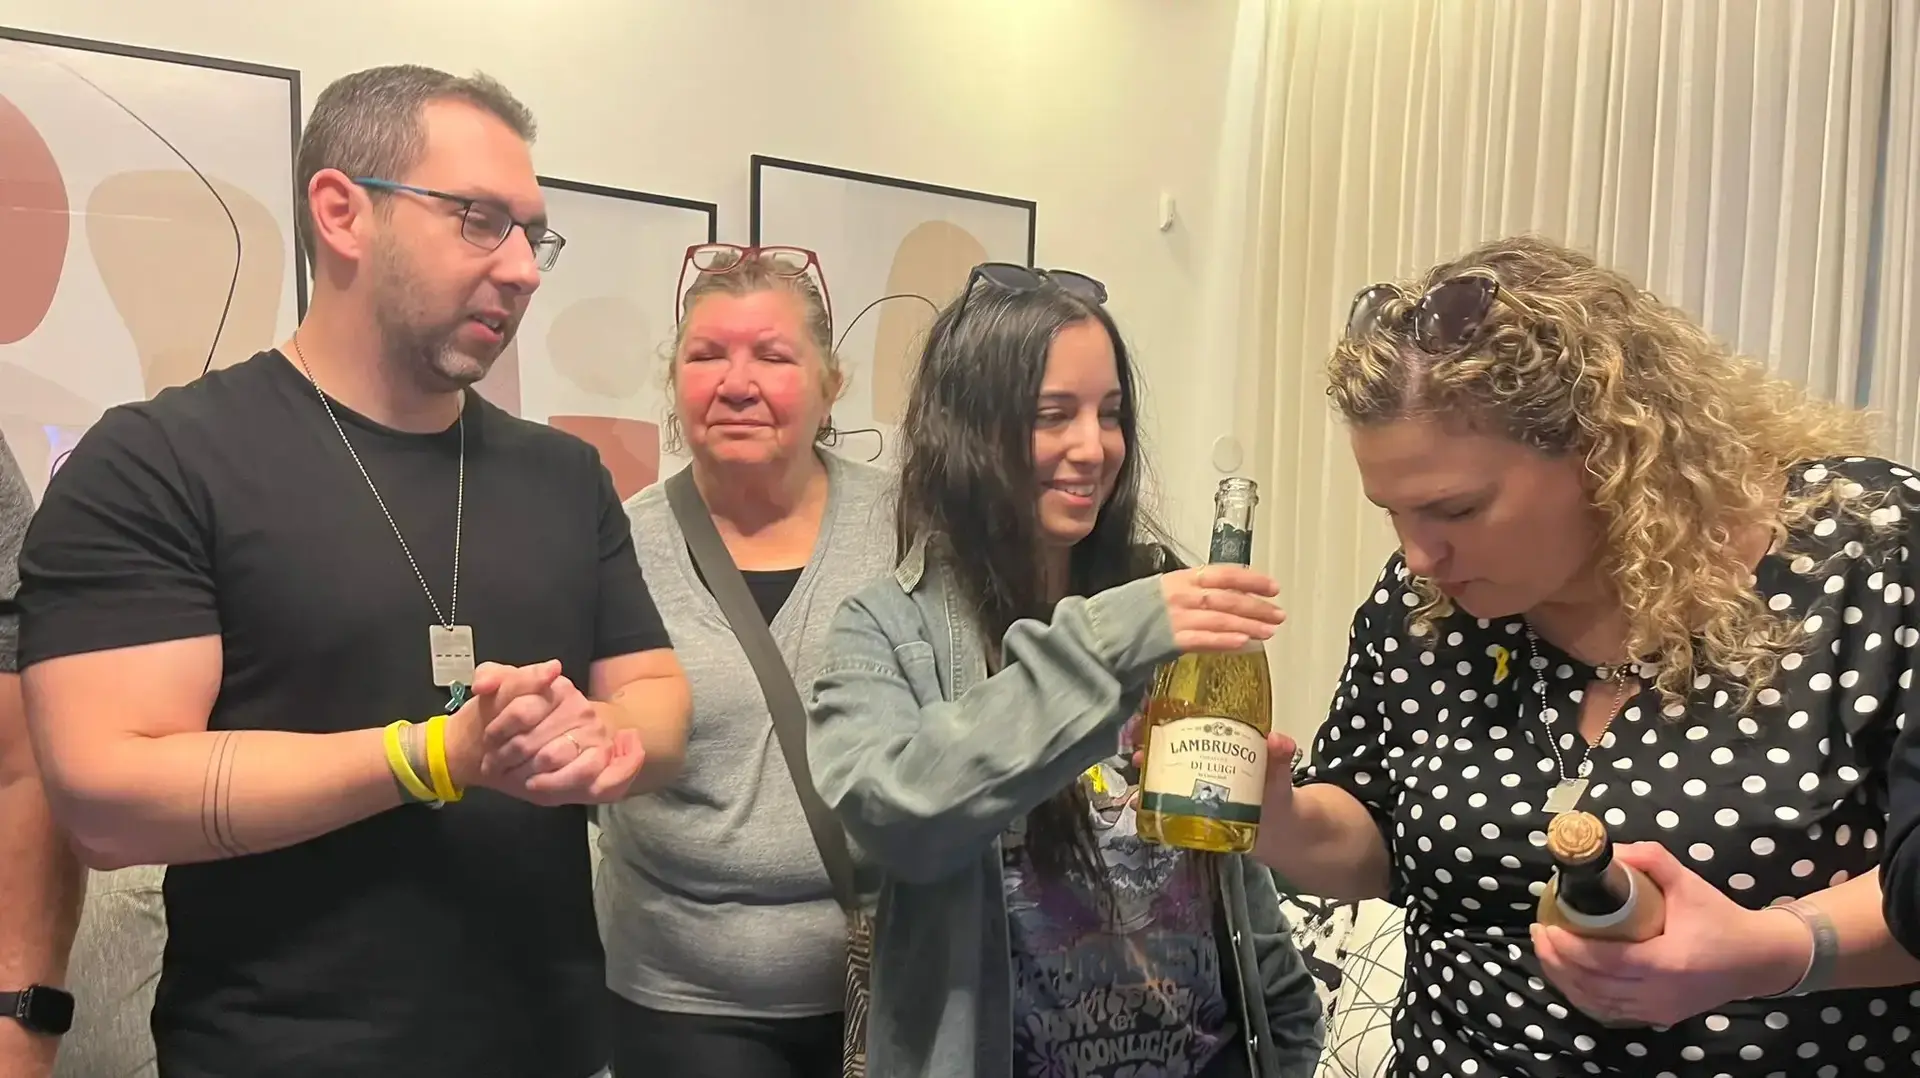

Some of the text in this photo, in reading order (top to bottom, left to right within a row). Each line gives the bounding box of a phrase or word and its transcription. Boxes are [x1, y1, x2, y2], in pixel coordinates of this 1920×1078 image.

[1170, 739, 1257, 764] LAMBRUSCO
[1190, 761, 1236, 775] DI LUIGI
[1058, 1026, 1192, 1075] MOONLIGHT
